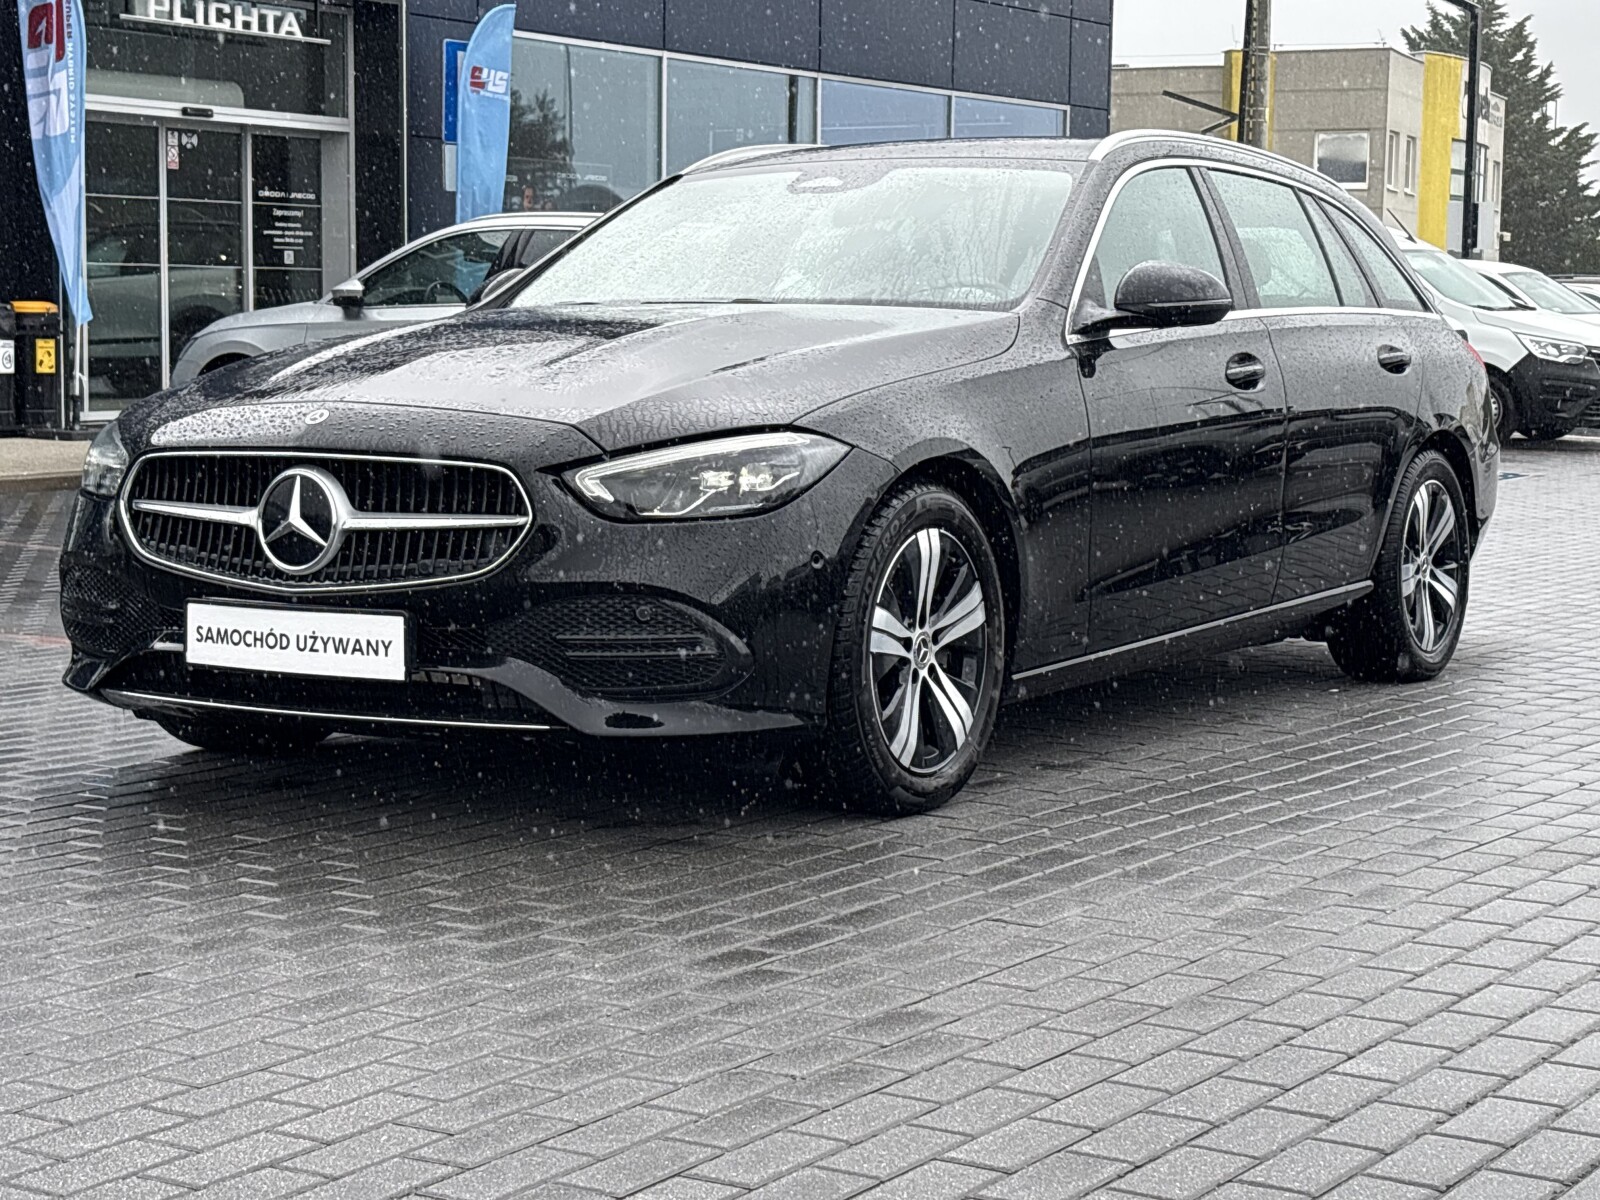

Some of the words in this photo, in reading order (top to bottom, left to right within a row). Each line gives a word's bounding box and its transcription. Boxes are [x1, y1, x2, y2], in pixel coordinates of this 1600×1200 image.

[148, 0, 303, 38] PLICHTA
[195, 624, 291, 651] SAMOCHÓD
[296, 630, 393, 658] UŻYWANY
